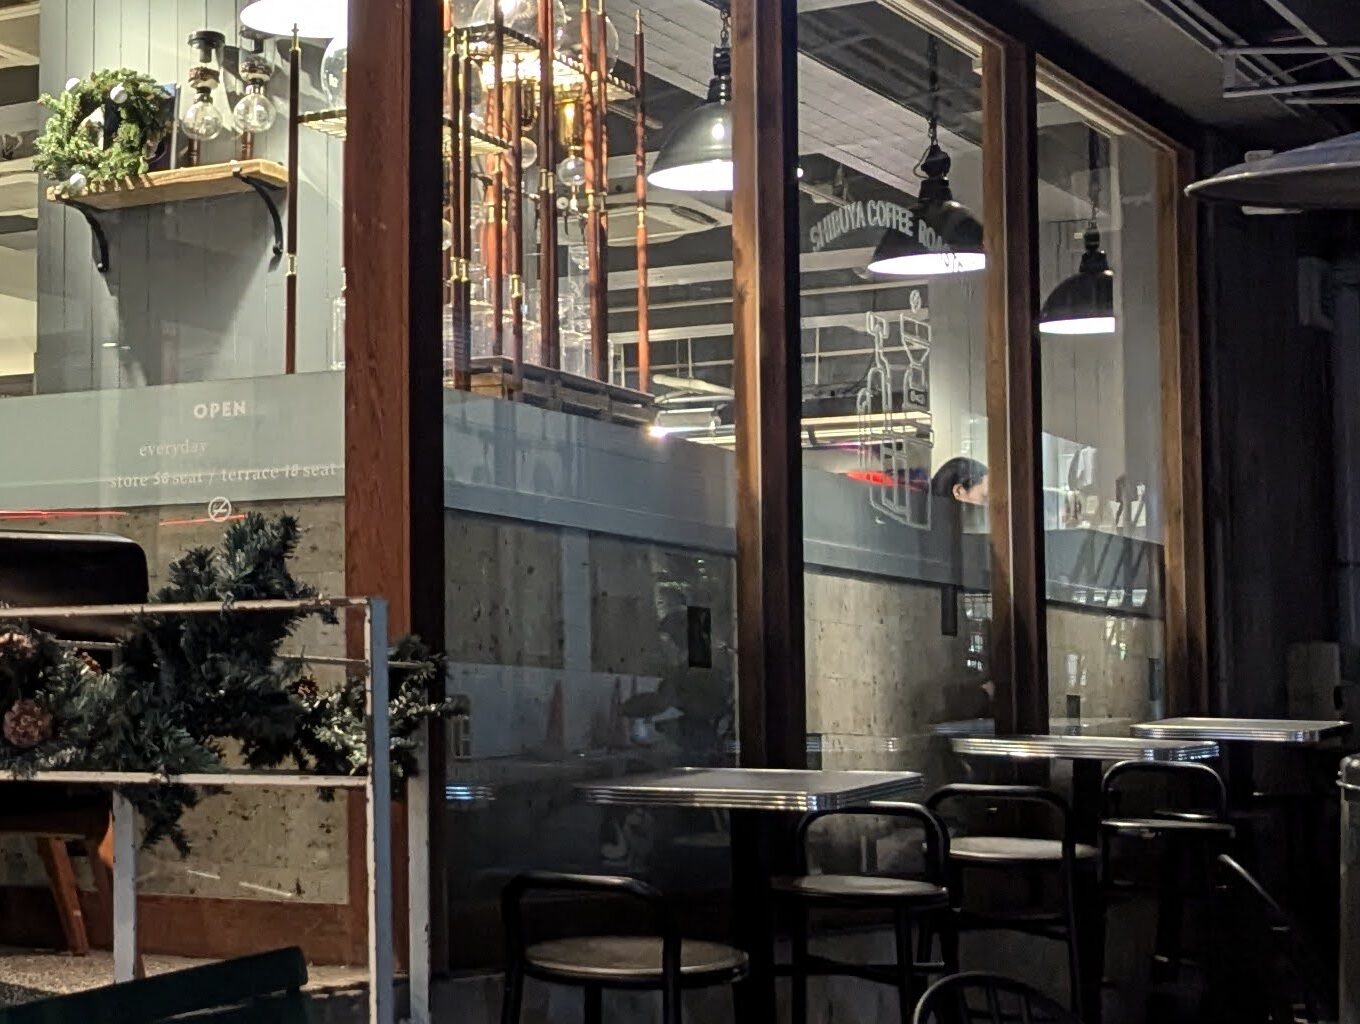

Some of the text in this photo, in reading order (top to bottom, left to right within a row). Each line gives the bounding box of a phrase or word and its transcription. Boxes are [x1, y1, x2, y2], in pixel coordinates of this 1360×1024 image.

[810, 201, 866, 252] SHIBUYA
[867, 199, 915, 237] COFFEE
[193, 400, 246, 419] OPEN
[139, 439, 208, 457] everyday
[222, 468, 280, 483] terrace
